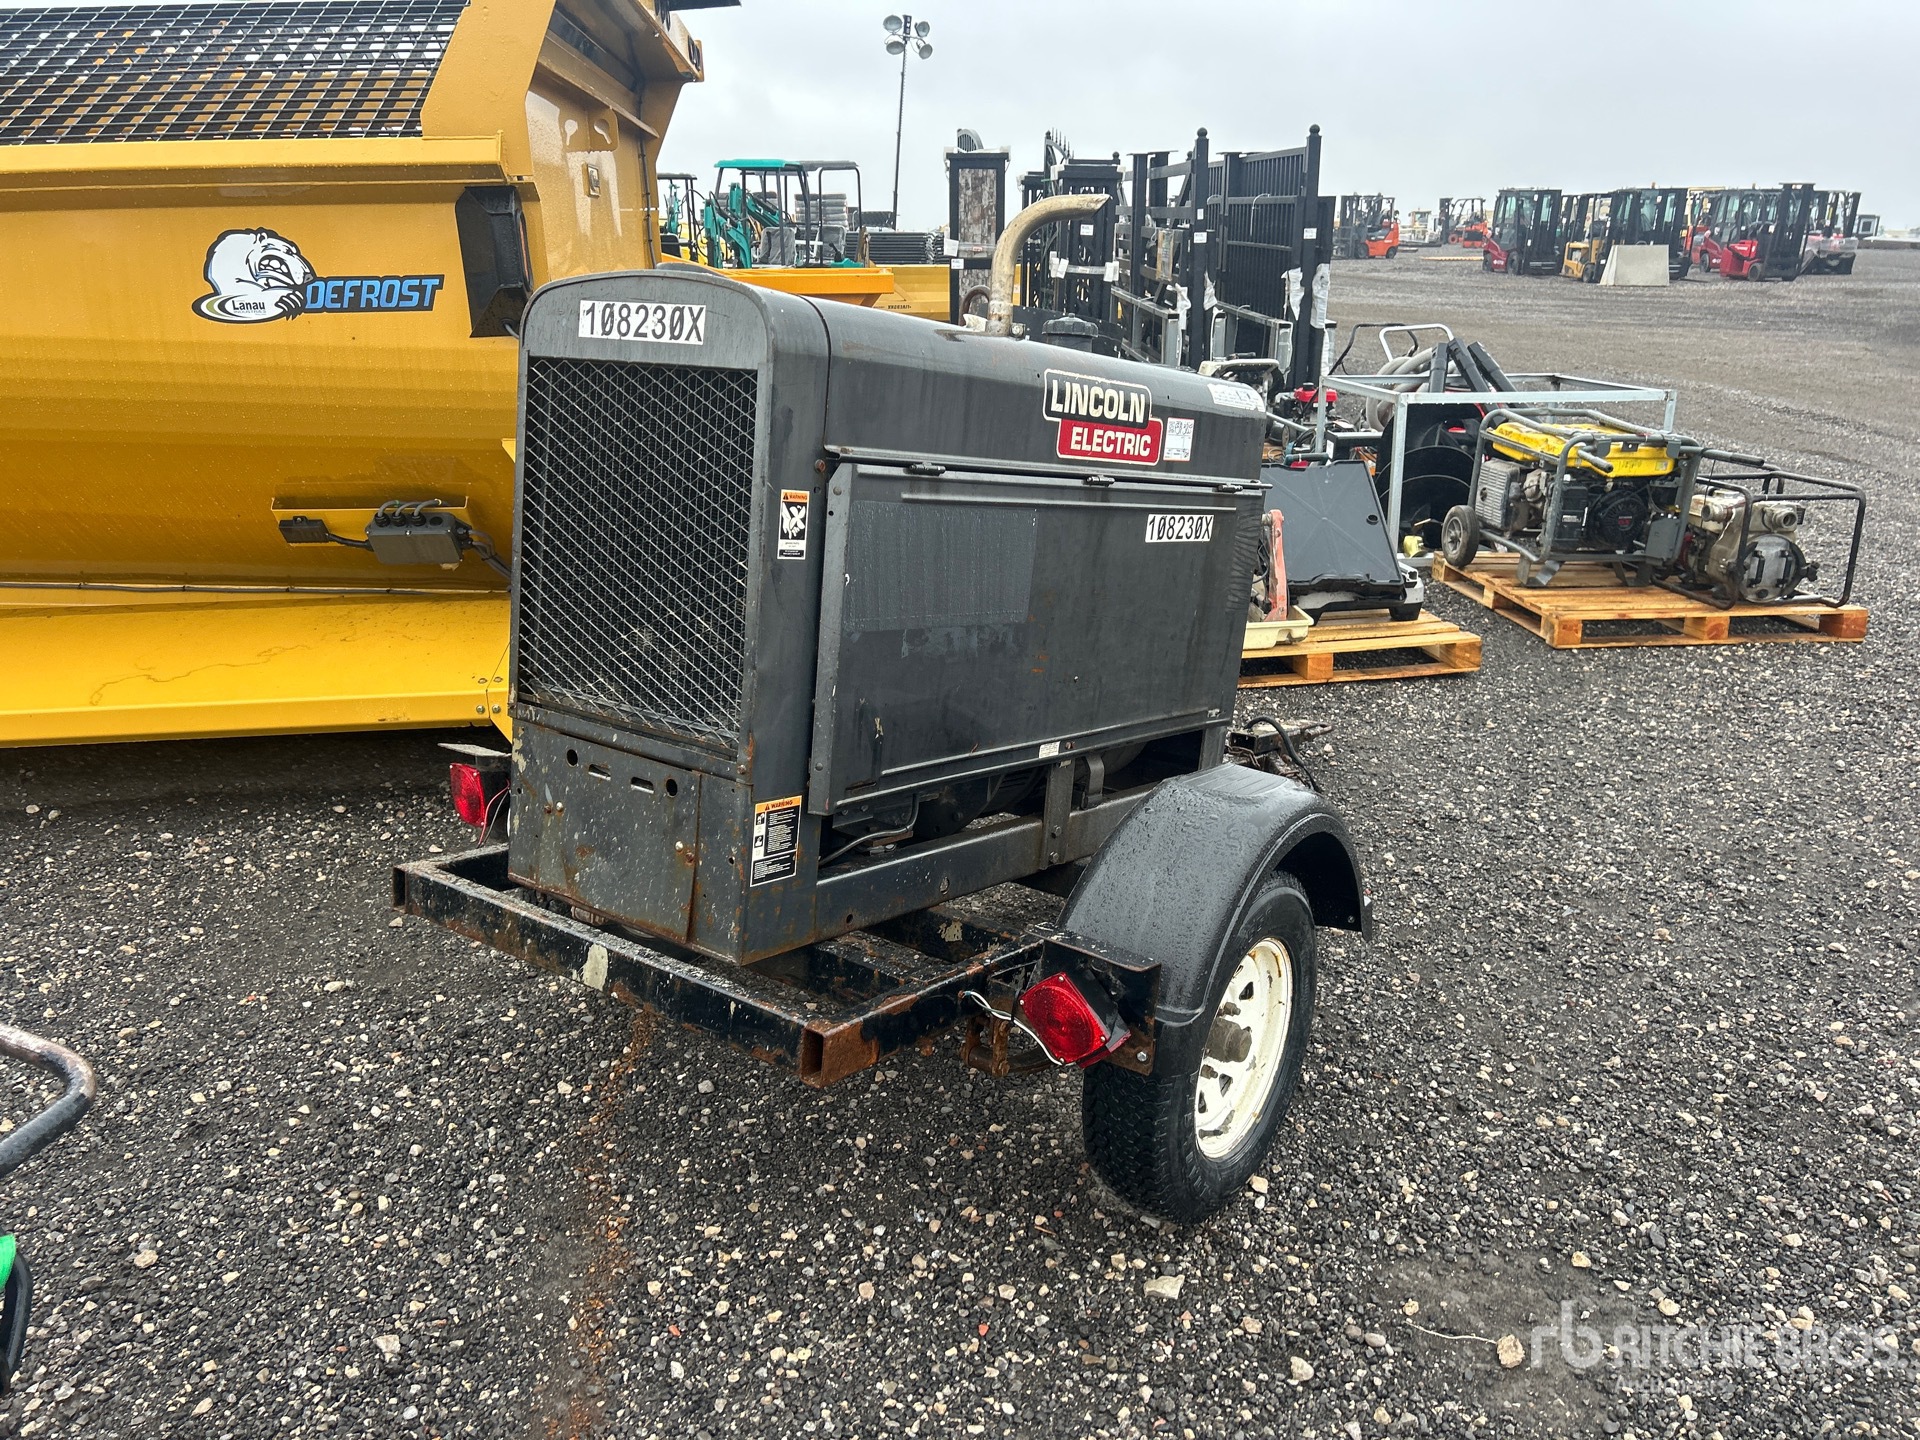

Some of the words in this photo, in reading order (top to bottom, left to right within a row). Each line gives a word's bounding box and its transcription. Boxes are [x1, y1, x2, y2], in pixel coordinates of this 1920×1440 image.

[231, 299, 266, 311] Lanau
[305, 277, 440, 310] DEFROST
[585, 302, 705, 342] 108230X
[1050, 379, 1146, 424] LINCOLN
[1070, 425, 1152, 458] ELECTRIC
[1149, 515, 1213, 541] 108230X
